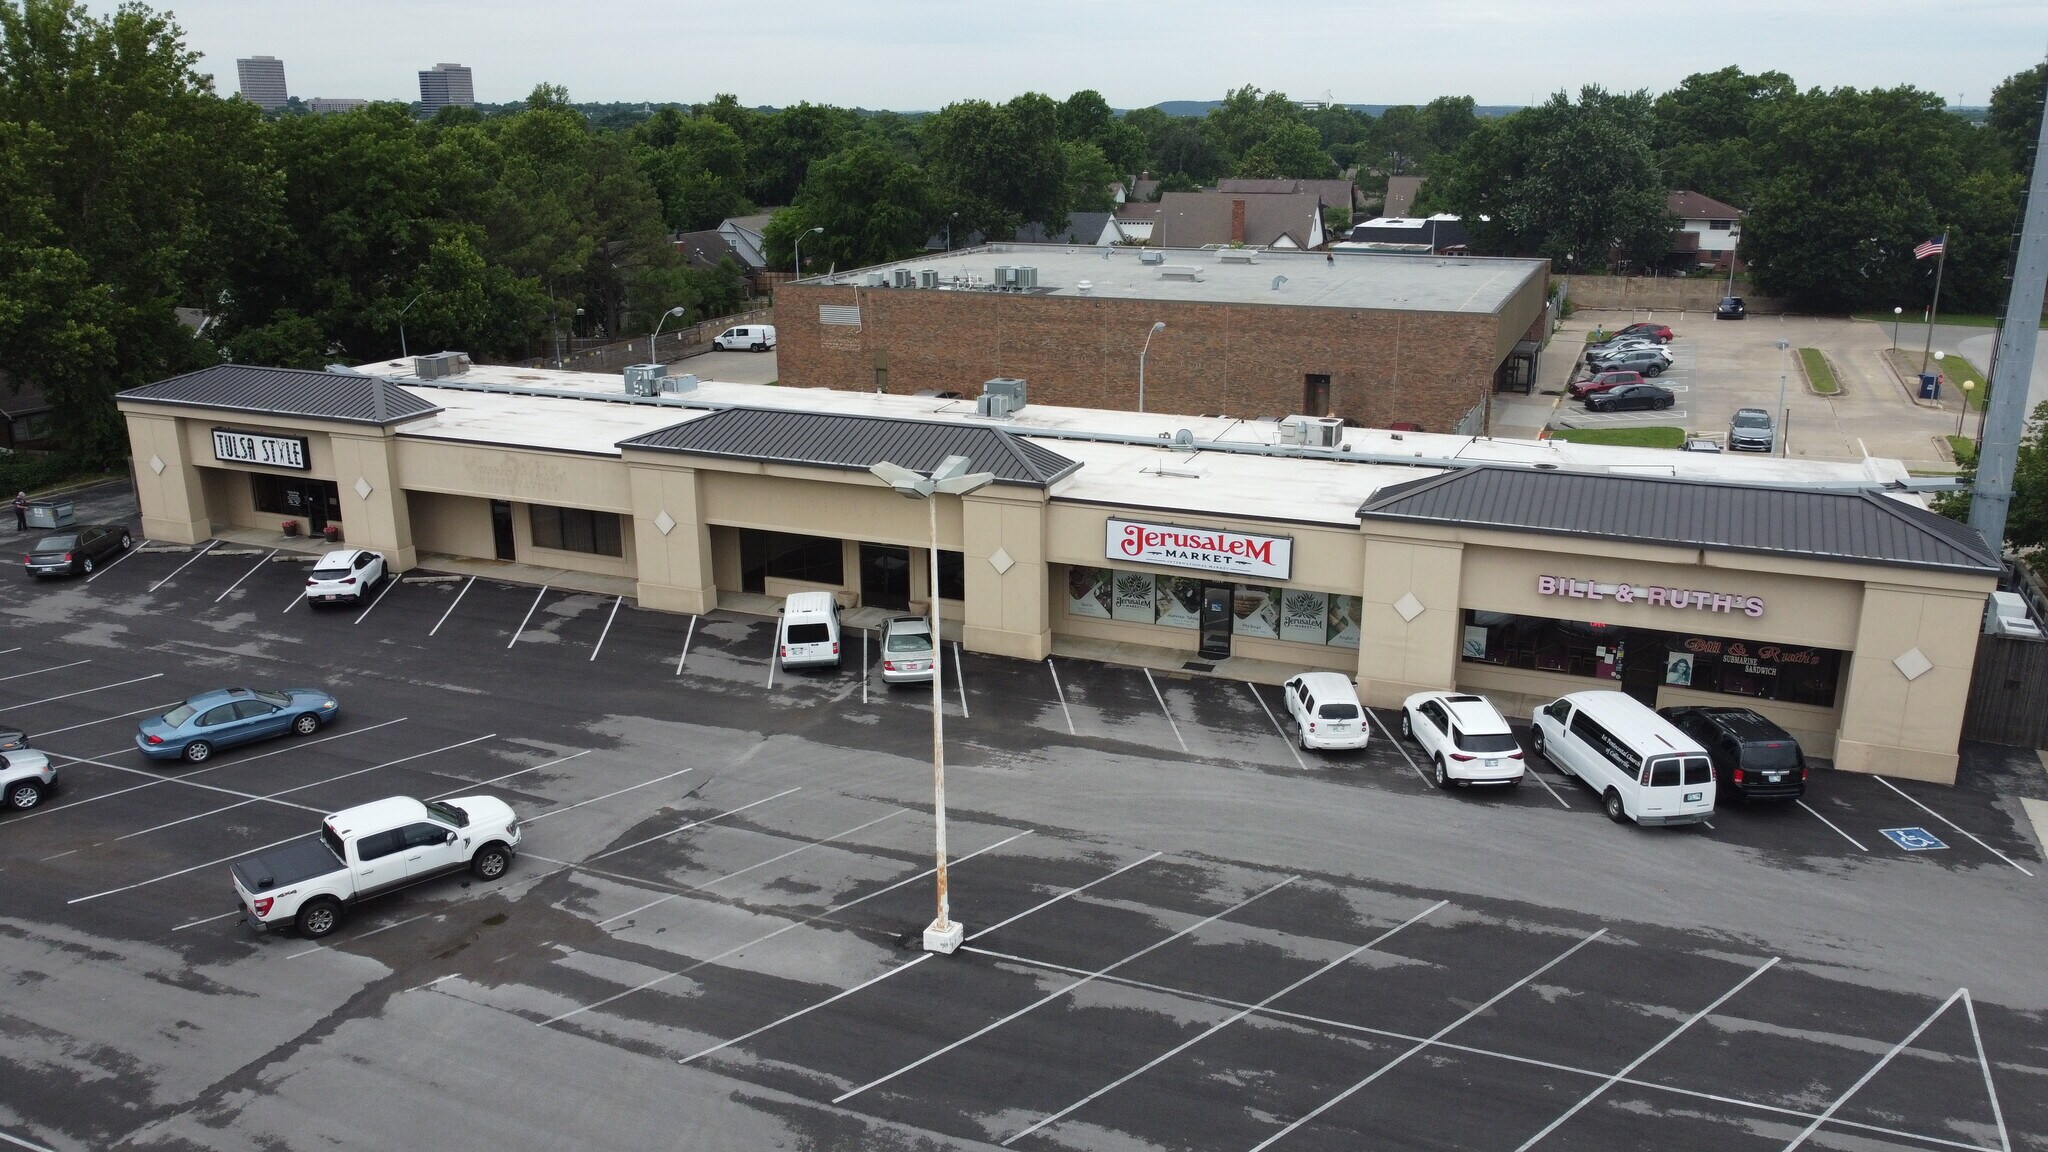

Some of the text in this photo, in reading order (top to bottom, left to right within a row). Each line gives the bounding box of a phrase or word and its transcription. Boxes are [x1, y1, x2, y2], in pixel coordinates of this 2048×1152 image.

[216, 434, 301, 465] TULSA STYLE
[1165, 549, 1232, 564] MARKET
[1166, 560, 1207, 568] INTERNATIONAL
[1537, 574, 1764, 618] BILL & RUTH'S
[1684, 638, 1820, 665] Bill & Ruth's
[1722, 654, 1758, 666] SUBMARINE
[1744, 665, 1777, 676] SANDWICH
